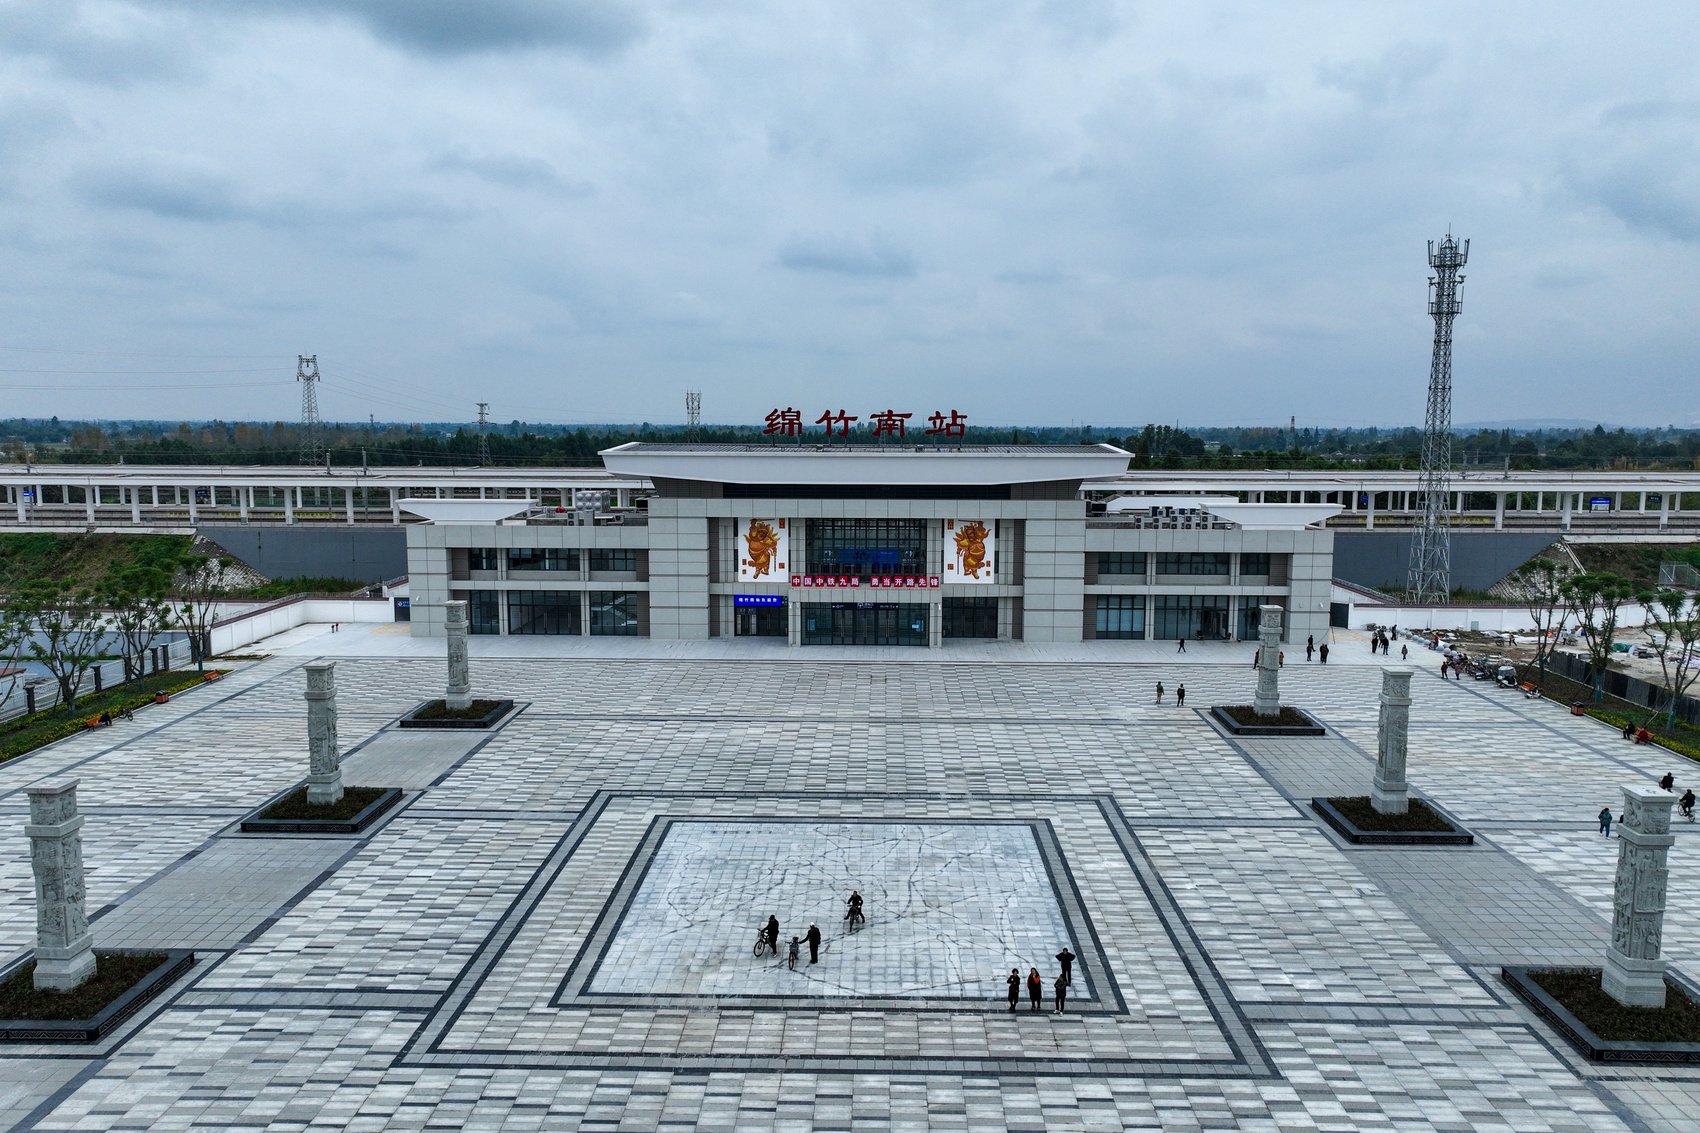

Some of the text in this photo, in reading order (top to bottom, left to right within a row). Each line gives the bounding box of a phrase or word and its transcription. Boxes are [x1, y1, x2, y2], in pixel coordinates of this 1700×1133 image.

[763, 407, 968, 437] 绵竹南站
[792, 577, 939, 587] 中国中铁九局 勇当开路先锋
